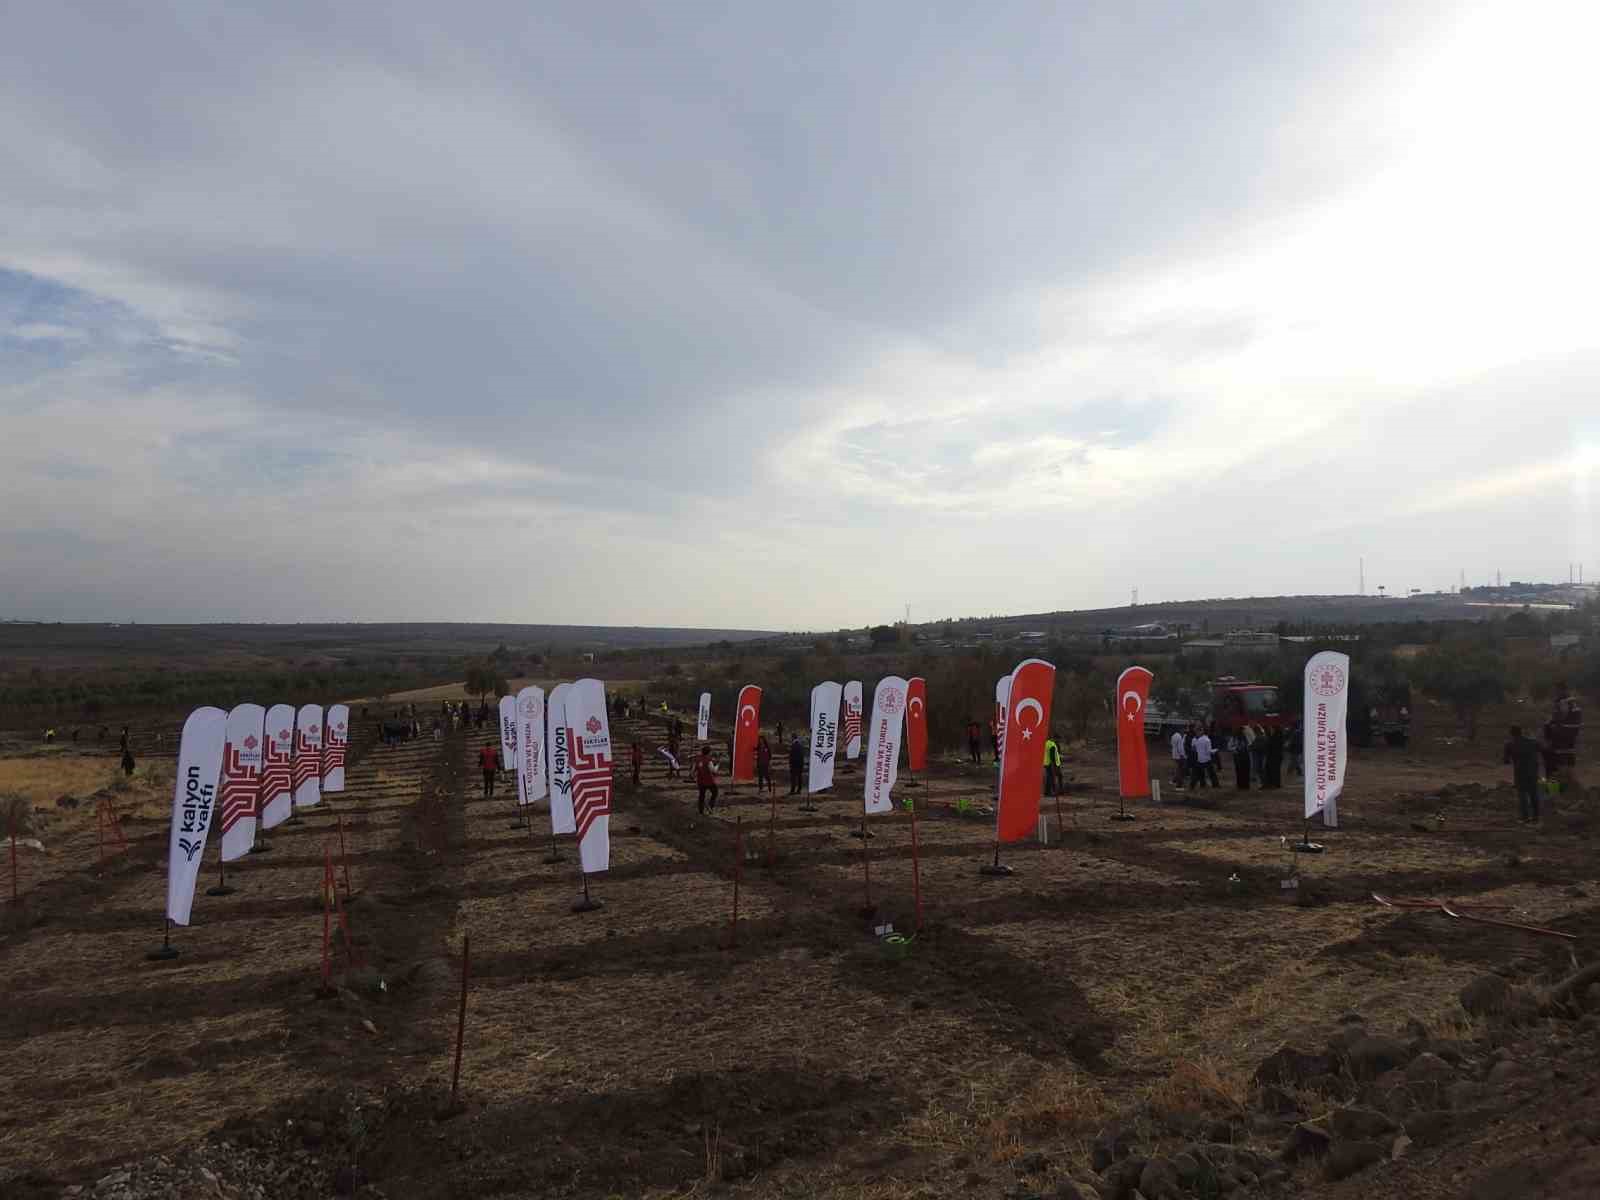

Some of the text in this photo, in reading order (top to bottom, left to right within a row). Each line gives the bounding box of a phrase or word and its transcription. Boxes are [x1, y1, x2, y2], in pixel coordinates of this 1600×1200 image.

[815, 712, 827, 749] kalyon
[826, 721, 837, 749] vakfı
[1316, 703, 1327, 737] TURİZM
[554, 727, 568, 774] kalyon
[1316, 738, 1326, 752] VE
[1327, 730, 1337, 781] BAKANLIĞI
[181, 766, 201, 833] kalyon
[197, 784, 214, 833] vakfı
